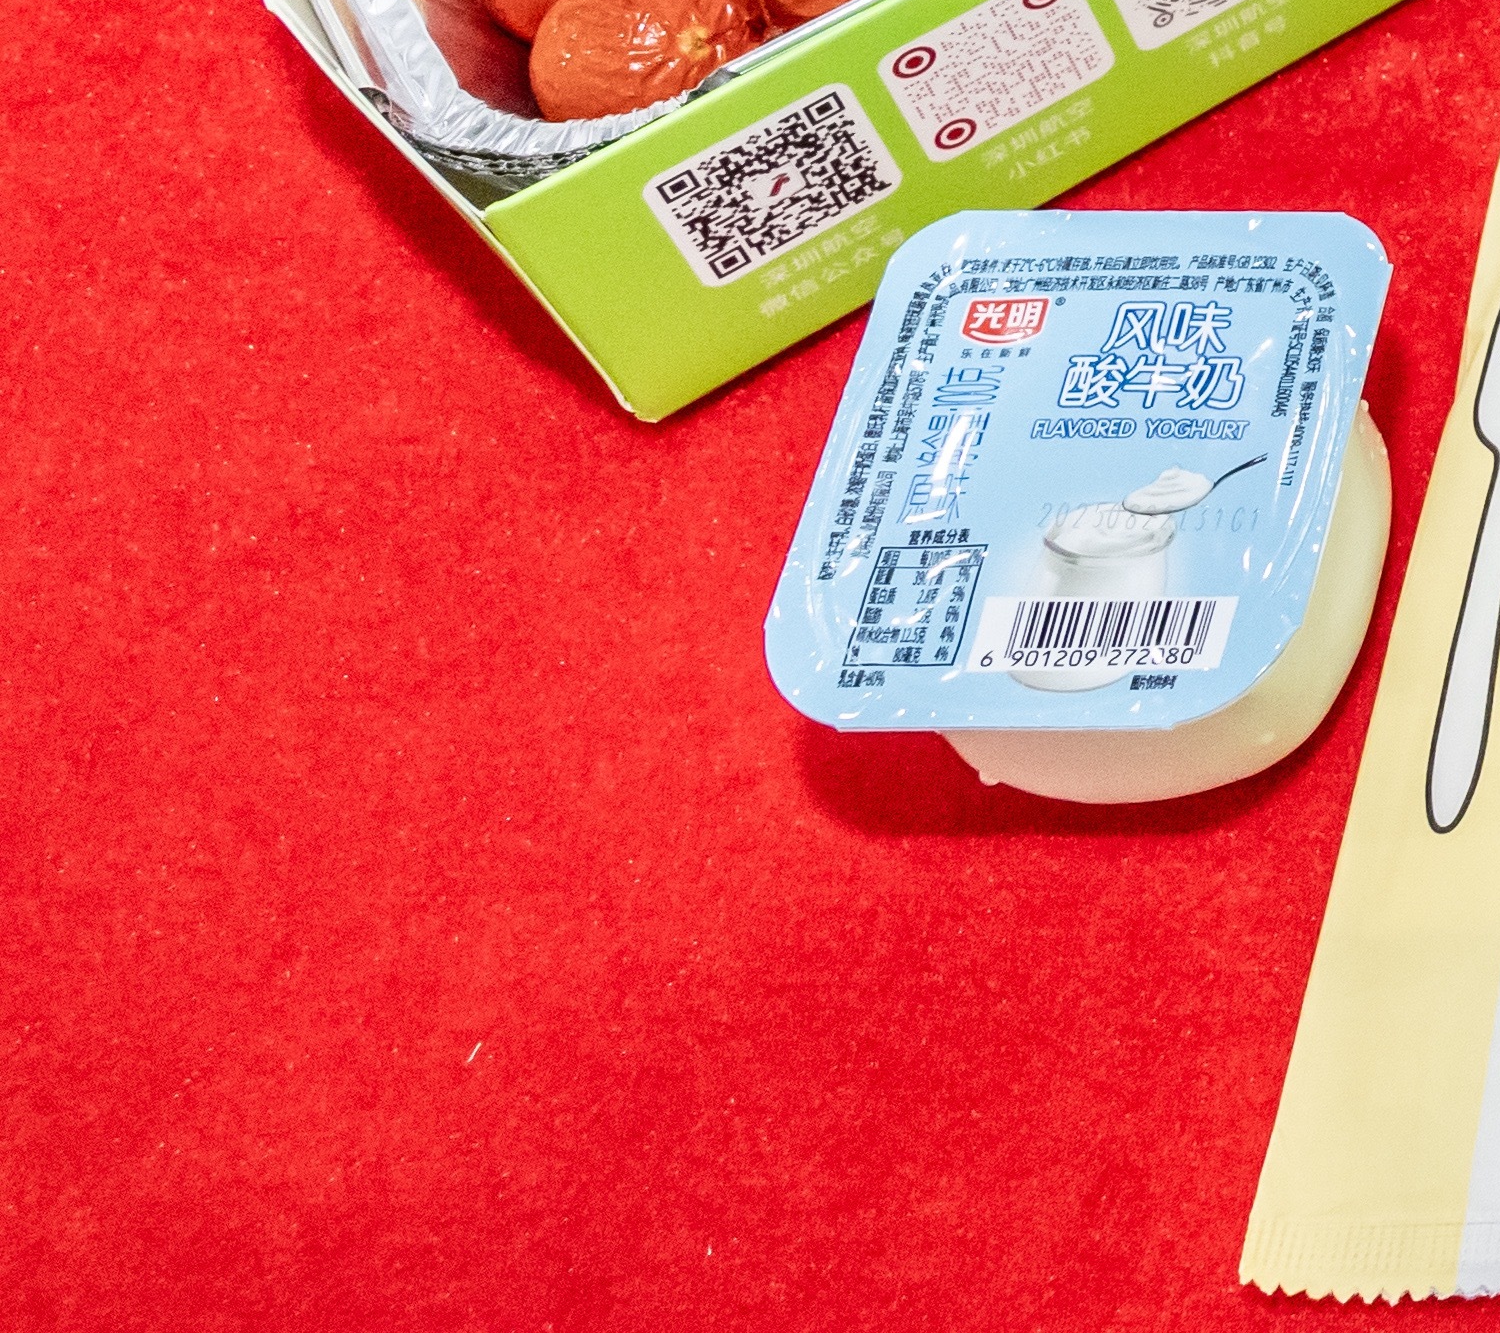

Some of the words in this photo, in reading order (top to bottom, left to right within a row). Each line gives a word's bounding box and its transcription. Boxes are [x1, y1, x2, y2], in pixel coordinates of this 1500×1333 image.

[969, 301, 1044, 329] 光明
[1100, 301, 1232, 355] 风味
[1058, 355, 1245, 410] 酸牛奶
[1032, 417, 1136, 440] FLAVORED
[1146, 418, 1250, 441] YOGHURT
[909, 529, 970, 545] 营养成分表
[980, 650, 994, 667] 6
[1011, 649, 1098, 667] 901209
